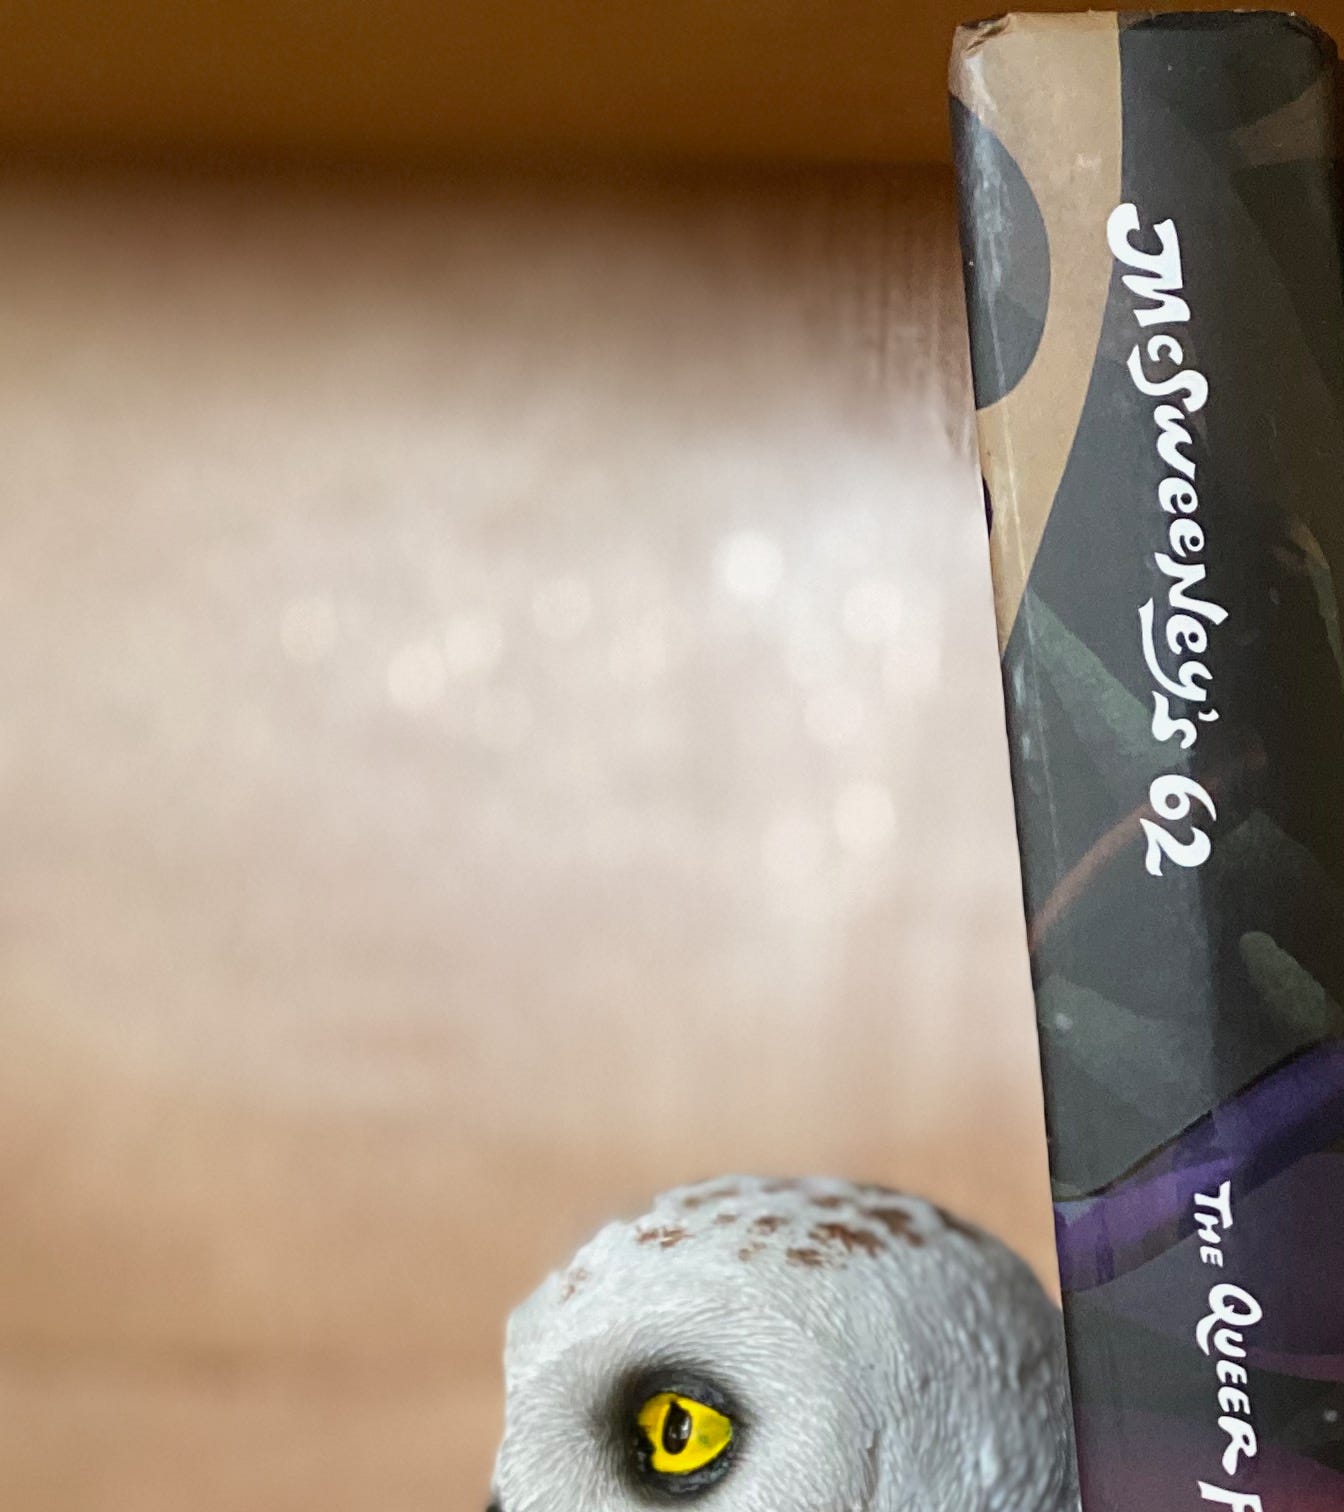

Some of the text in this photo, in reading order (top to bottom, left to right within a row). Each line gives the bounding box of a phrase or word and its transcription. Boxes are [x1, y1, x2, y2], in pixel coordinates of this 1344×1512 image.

[1138, 774, 1216, 877] 62
[1194, 1180, 1234, 1268] THE
[1196, 1282, 1264, 1476] QUEER
